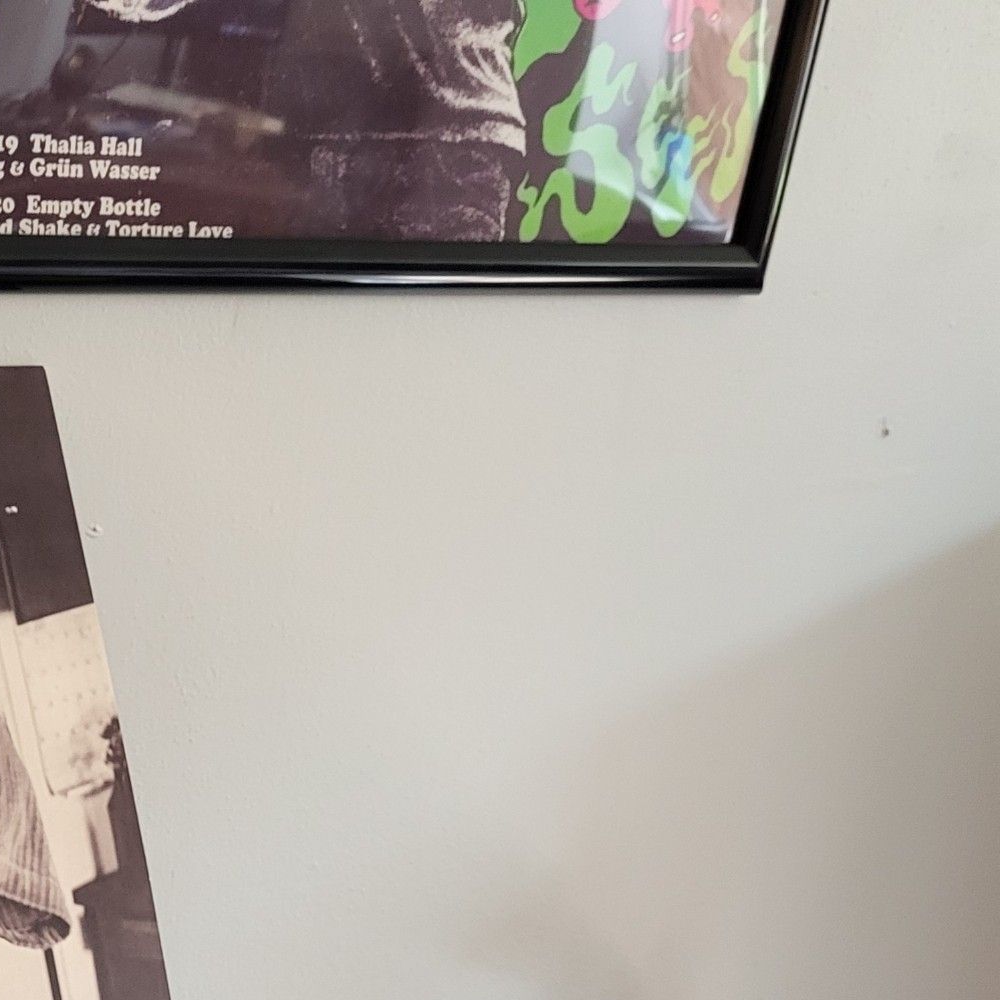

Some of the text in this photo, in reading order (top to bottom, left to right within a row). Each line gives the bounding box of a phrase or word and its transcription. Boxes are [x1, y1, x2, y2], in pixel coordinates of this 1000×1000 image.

[30, 133, 96, 156] Thalia
[100, 136, 144, 157] Hall
[9, 161, 25, 176] &
[29, 158, 84, 179] Grün
[89, 160, 161, 180] Wasser
[26, 195, 95, 219] Empty
[99, 197, 162, 218] Bottle
[18, 218, 83, 236] Shake
[104, 221, 184, 239] Torture
[187, 221, 235, 240] Love
